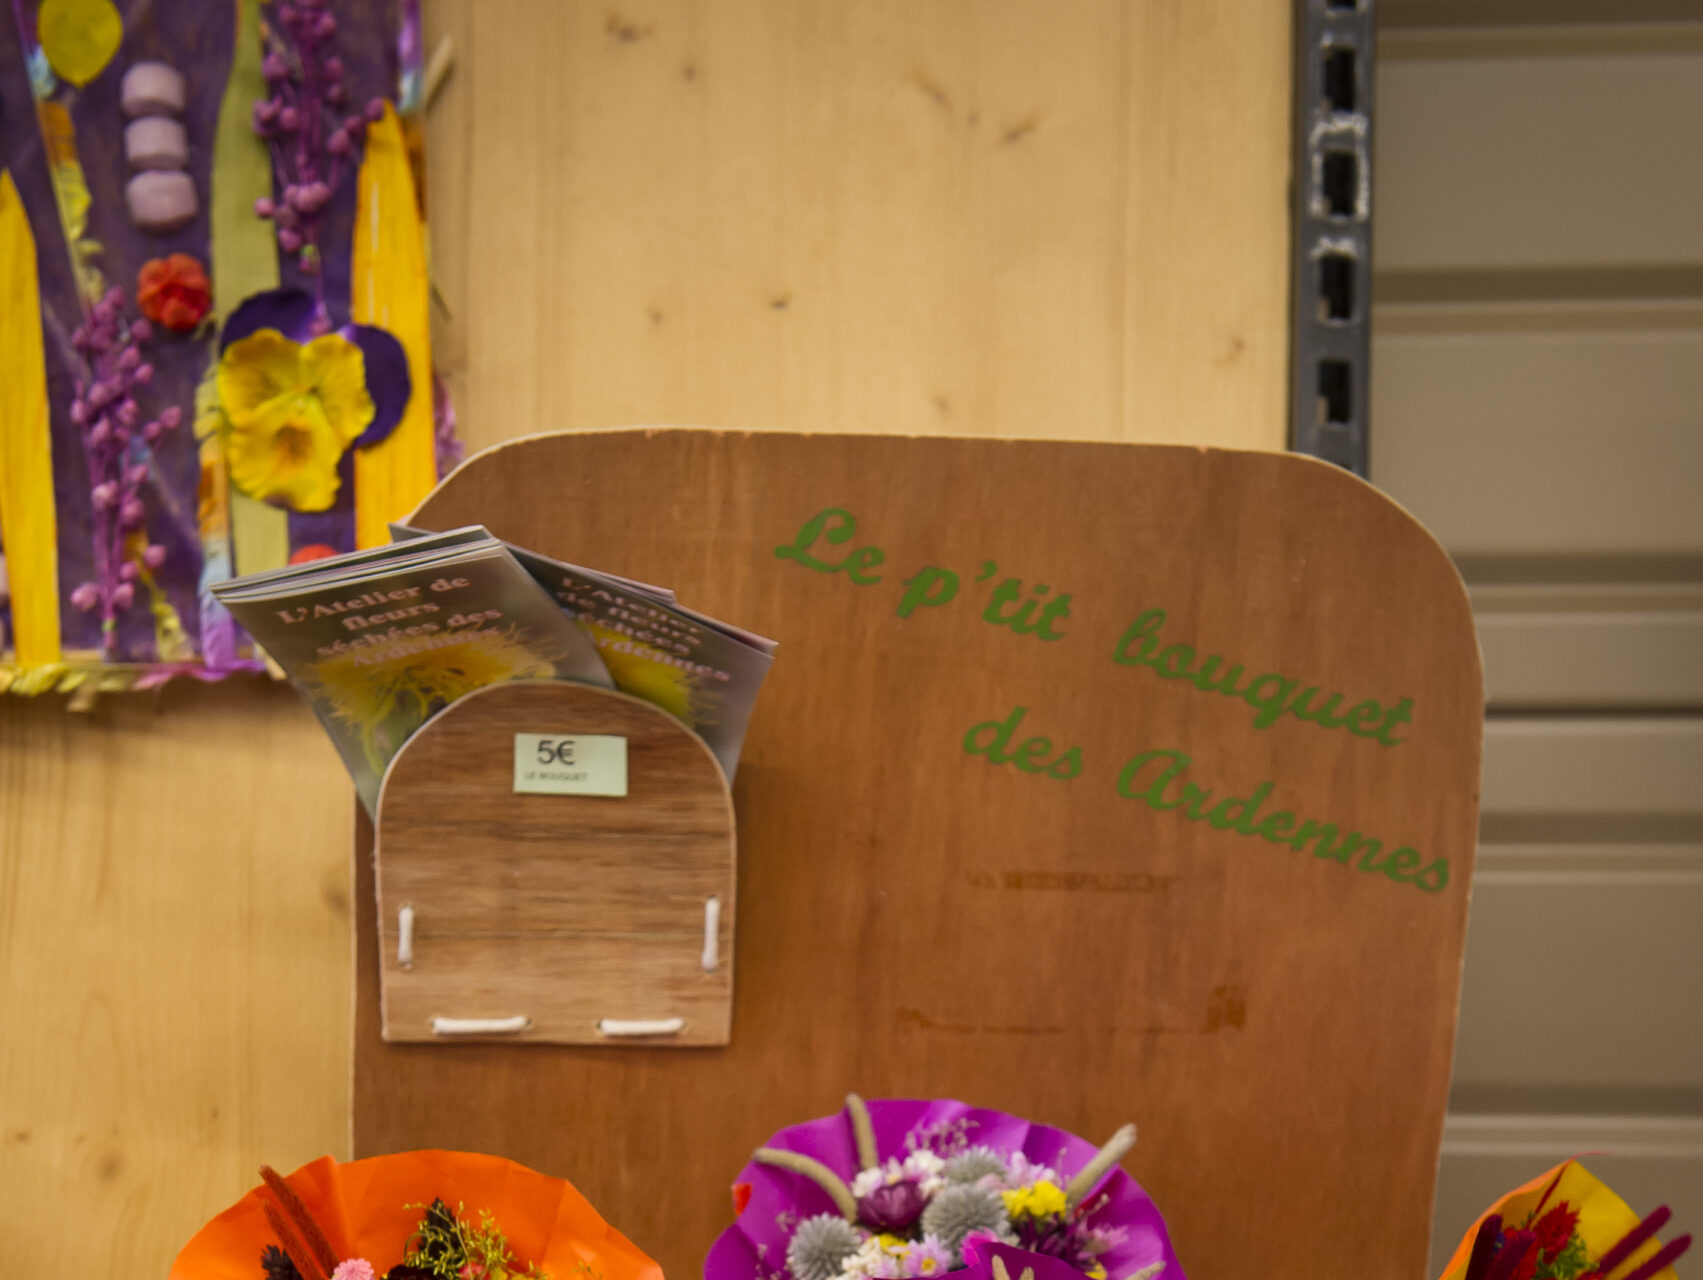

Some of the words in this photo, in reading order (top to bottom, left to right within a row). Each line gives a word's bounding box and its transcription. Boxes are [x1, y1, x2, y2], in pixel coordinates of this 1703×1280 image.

[430, 577, 471, 592] de
[342, 602, 441, 631] fleurs
[446, 608, 502, 628] des
[773, 508, 885, 586] Le
[1112, 608, 1414, 747] bouquet
[537, 740, 576, 766] 5€
[962, 707, 1084, 780] des
[1116, 749, 1450, 893] Ardennes
